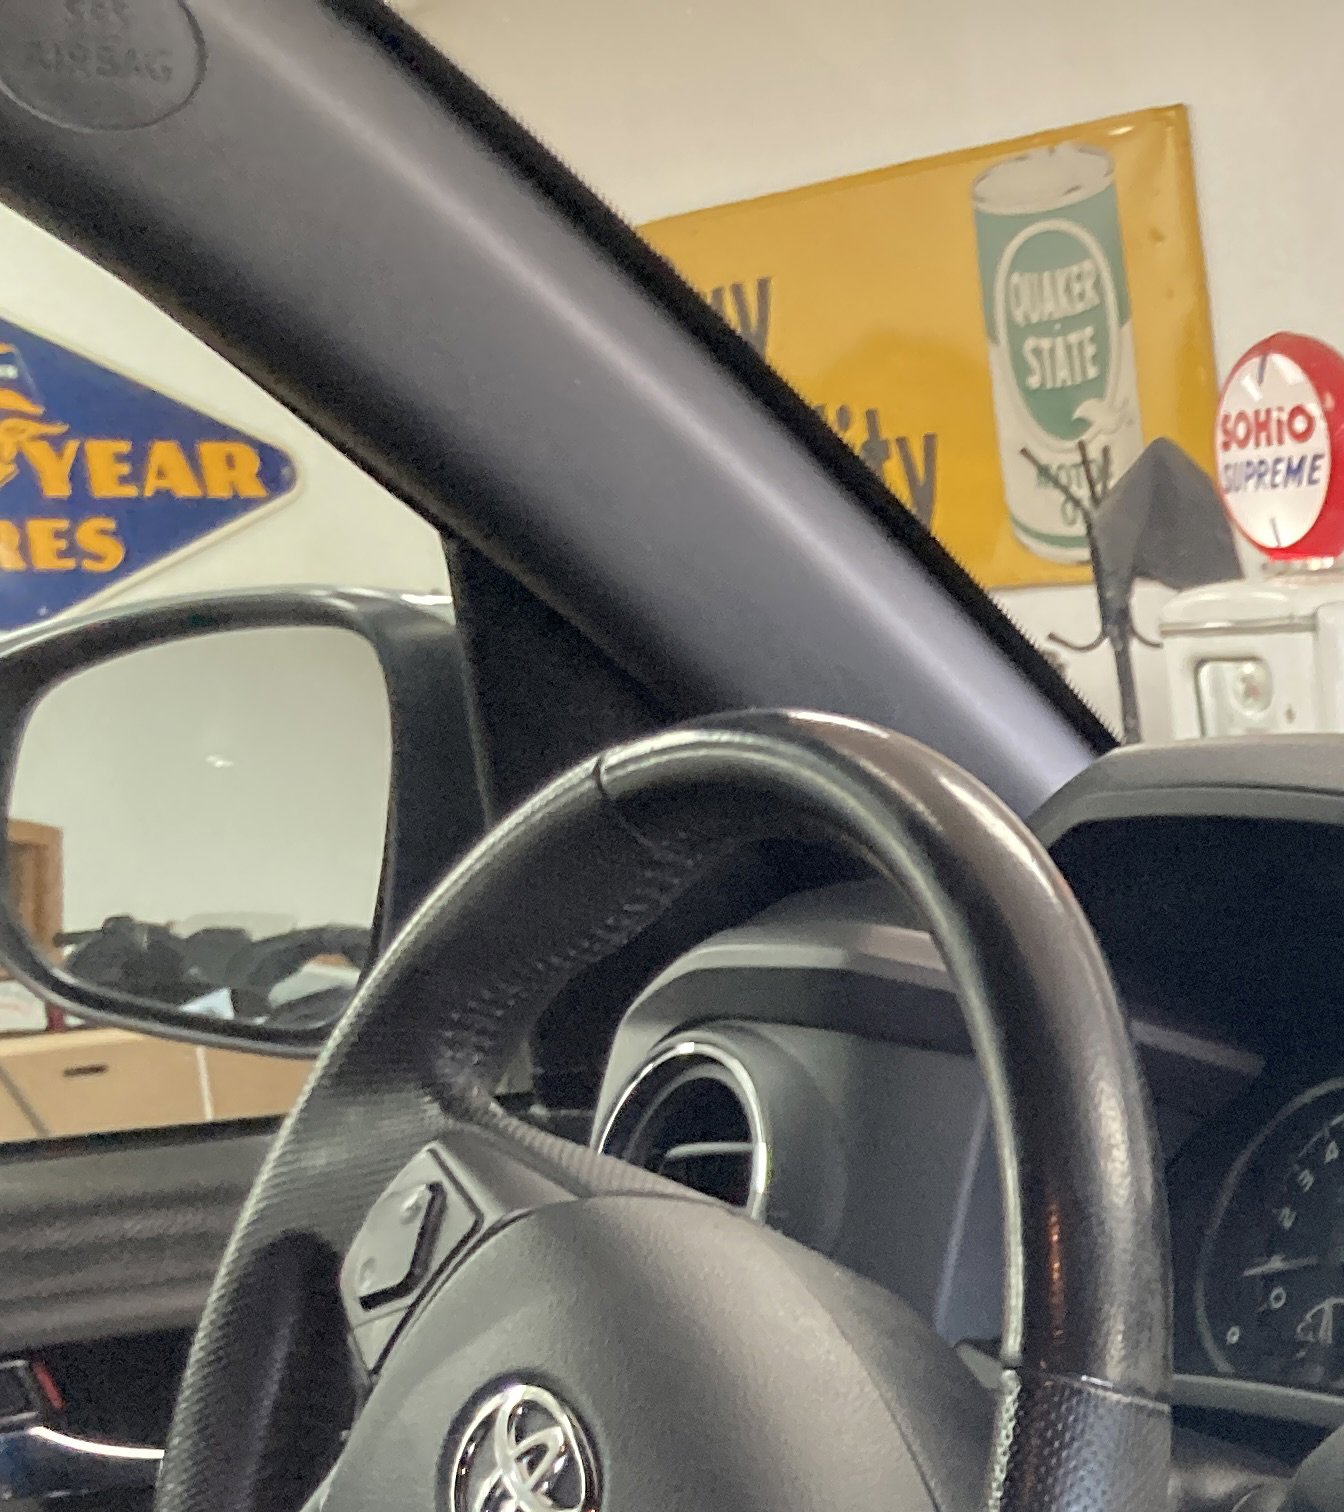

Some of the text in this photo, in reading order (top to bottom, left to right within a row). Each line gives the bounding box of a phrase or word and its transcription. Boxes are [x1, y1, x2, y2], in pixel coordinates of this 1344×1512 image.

[1010, 261, 1099, 326] QUAKER
[1023, 328, 1098, 390] STATE
[1222, 451, 1327, 496] SUPREME
